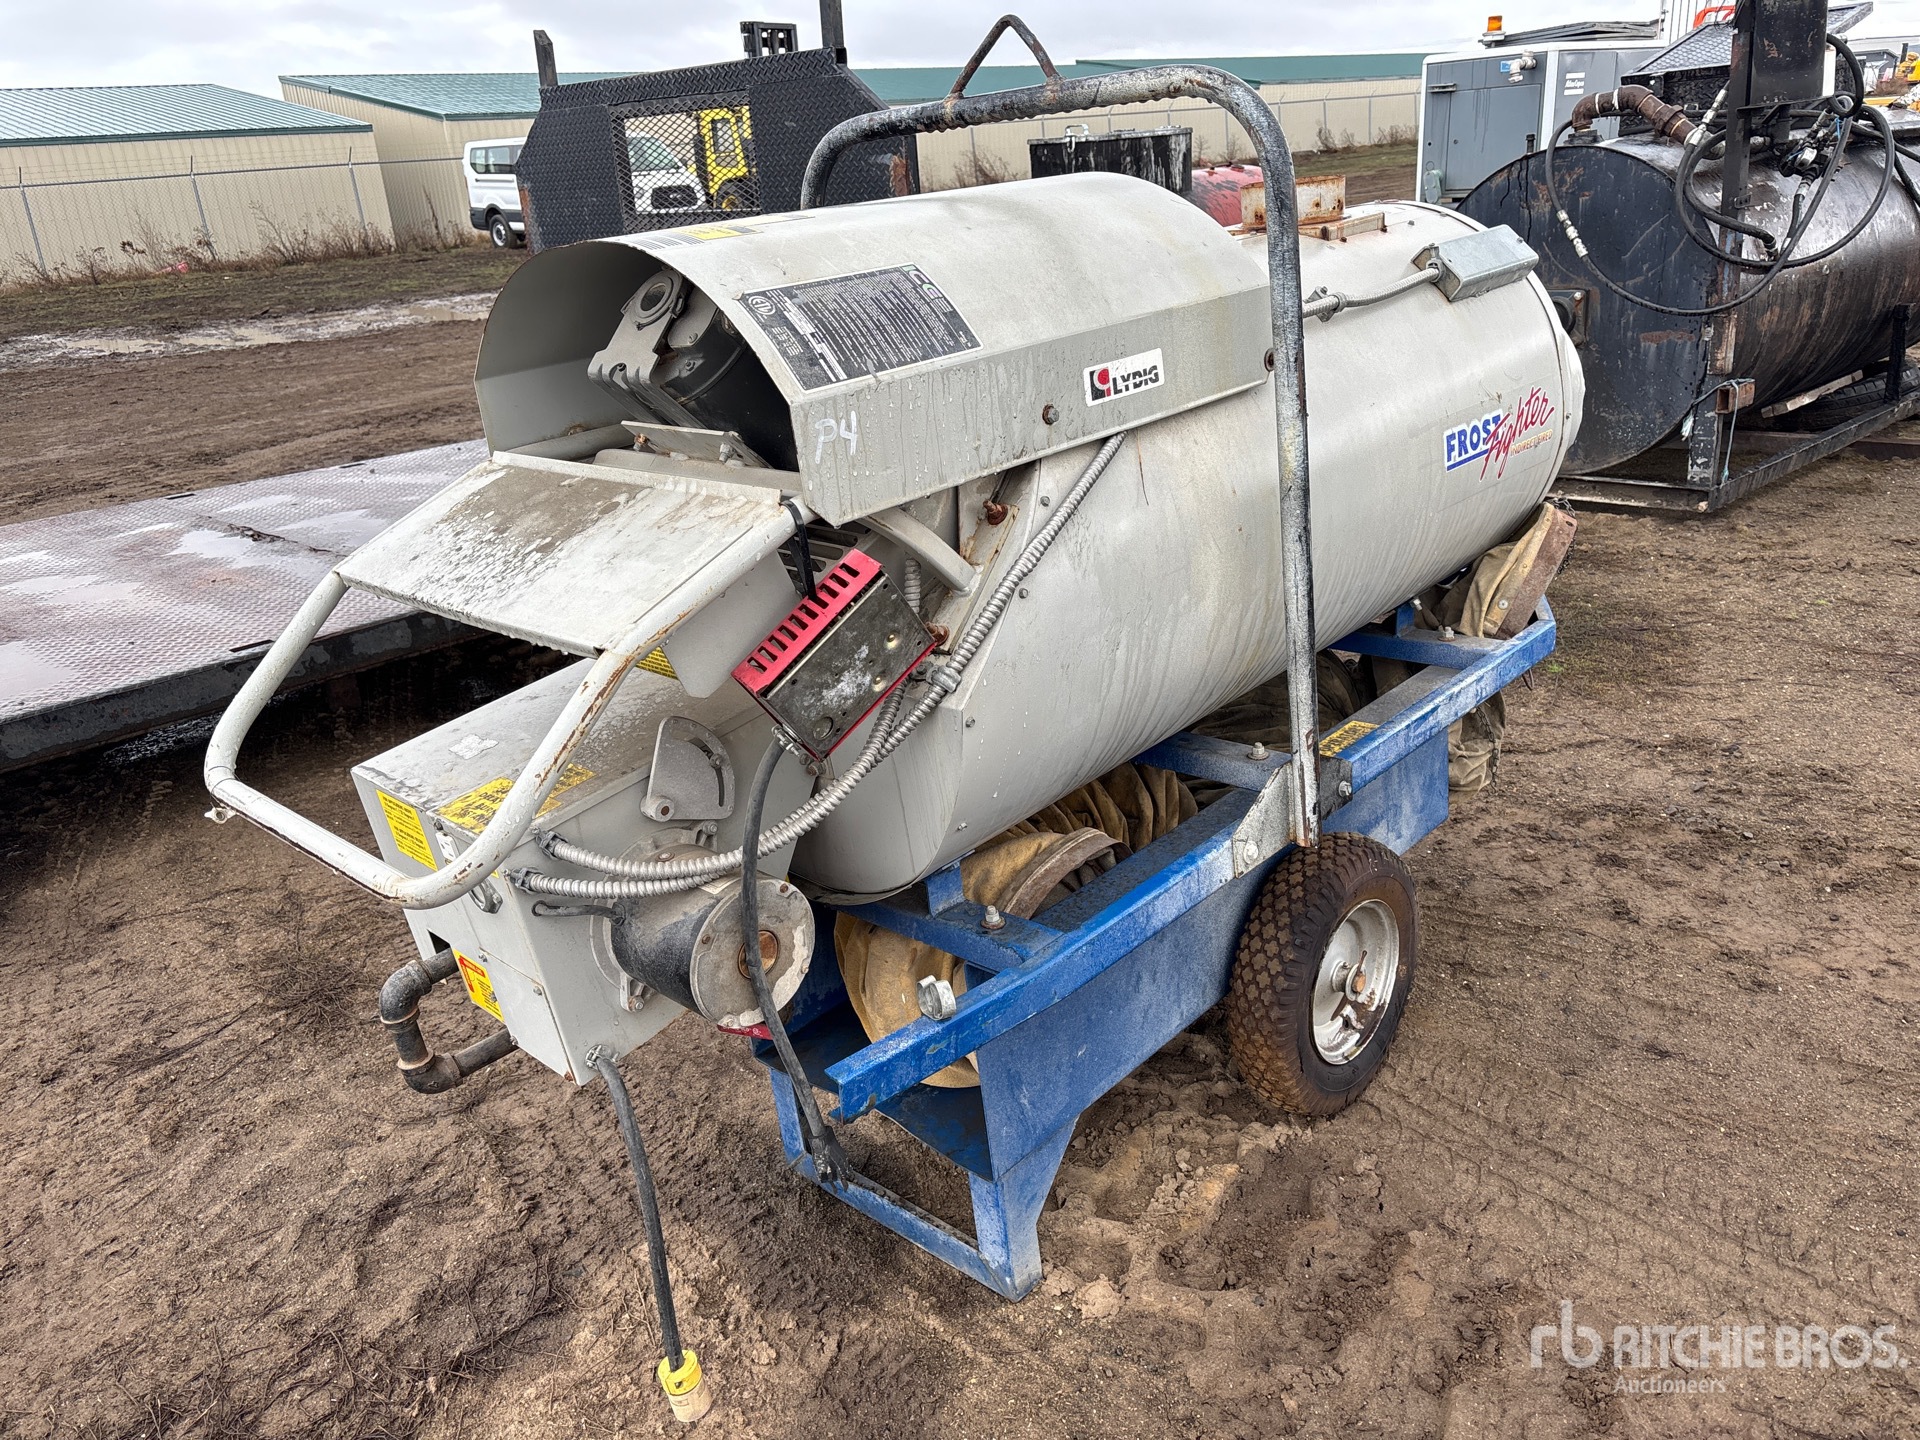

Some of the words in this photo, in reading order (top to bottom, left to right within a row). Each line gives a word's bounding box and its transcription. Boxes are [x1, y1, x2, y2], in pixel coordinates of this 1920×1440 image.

[1112, 365, 1160, 395] LYDIG
[815, 410, 858, 465] P4
[1446, 413, 1502, 463] FROST
[1480, 386, 1555, 481] Fighter
